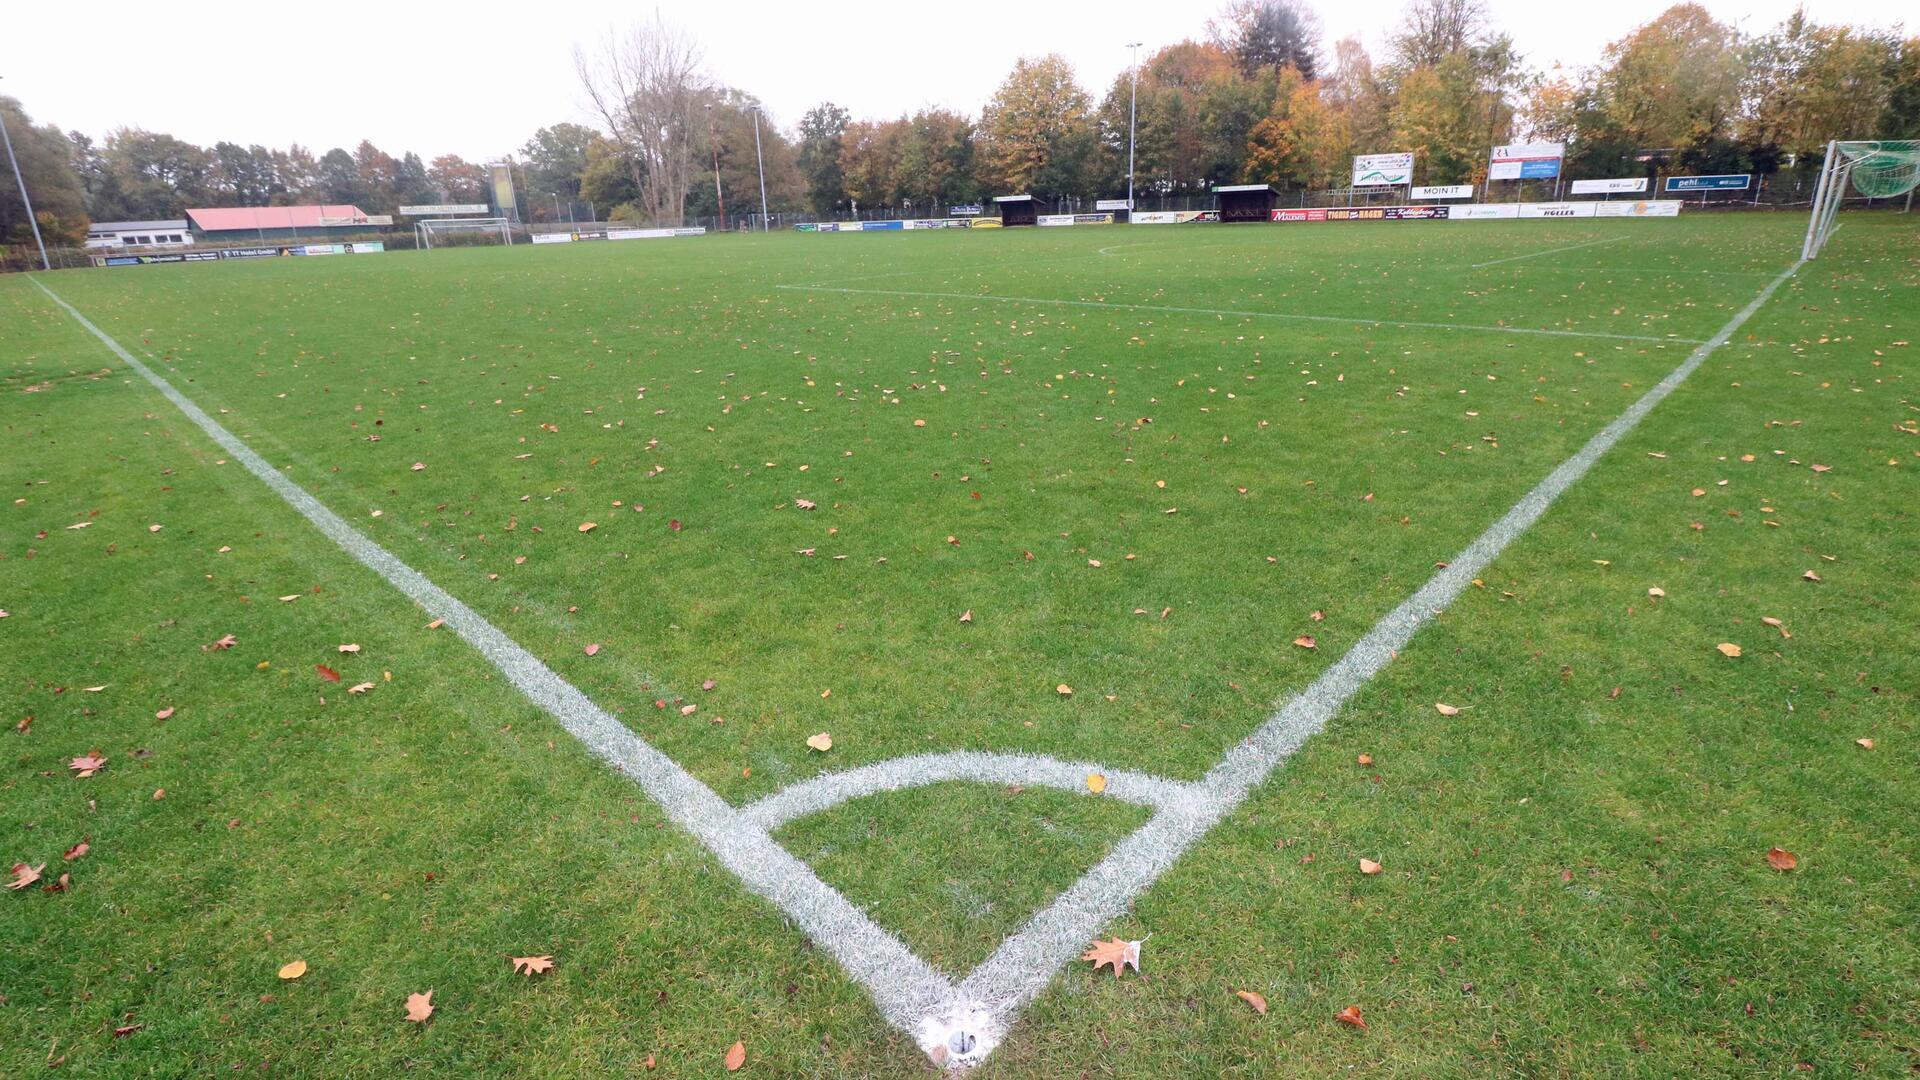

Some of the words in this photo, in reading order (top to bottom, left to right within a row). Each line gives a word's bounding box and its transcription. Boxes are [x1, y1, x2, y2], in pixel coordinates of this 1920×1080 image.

[1423, 187, 1448, 195] MOIN
[1451, 186, 1460, 194] IT
[1359, 210, 1383, 219] HAGEN
